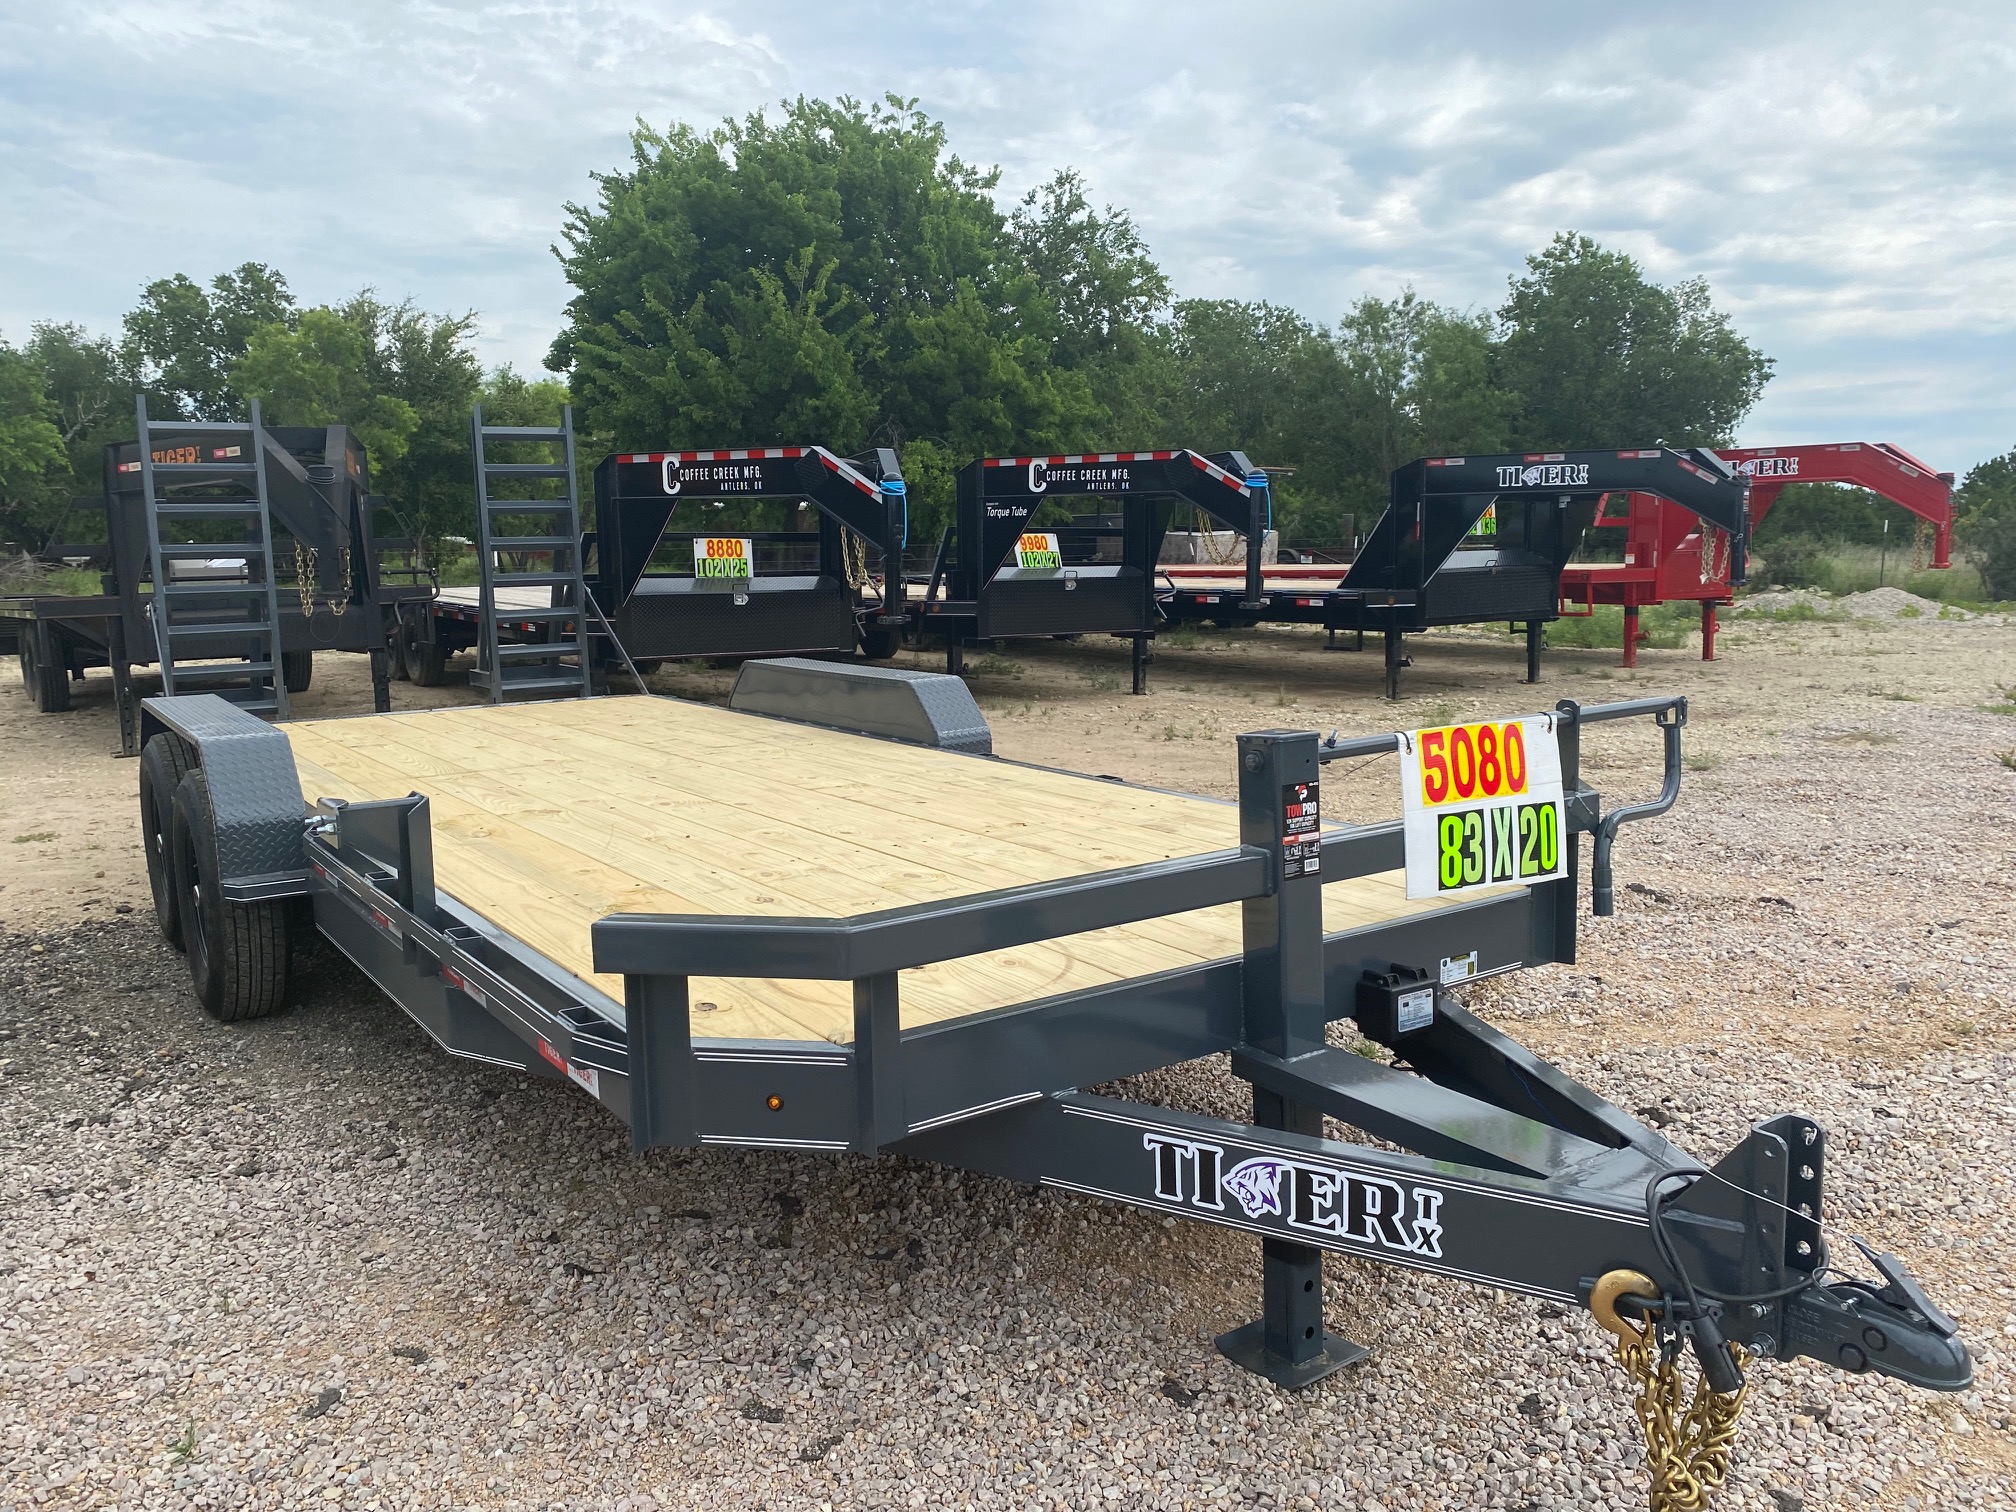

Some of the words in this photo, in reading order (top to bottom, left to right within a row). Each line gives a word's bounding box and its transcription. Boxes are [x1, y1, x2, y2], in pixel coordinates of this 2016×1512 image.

[680, 466, 710, 482] COFFEE
[714, 466, 740, 480] CREEK
[743, 465, 763, 479] MFG.
[1046, 470, 1076, 482] COFFEE
[1080, 468, 1107, 481] CREEK
[1111, 468, 1130, 480] MFG.
[754, 480, 763, 490] OK
[986, 506, 1010, 519] Torque
[1012, 506, 1028, 516] Tube
[706, 538, 744, 558] 8880
[1019, 534, 1048, 551] 9980
[1421, 723, 1527, 804] 5080
